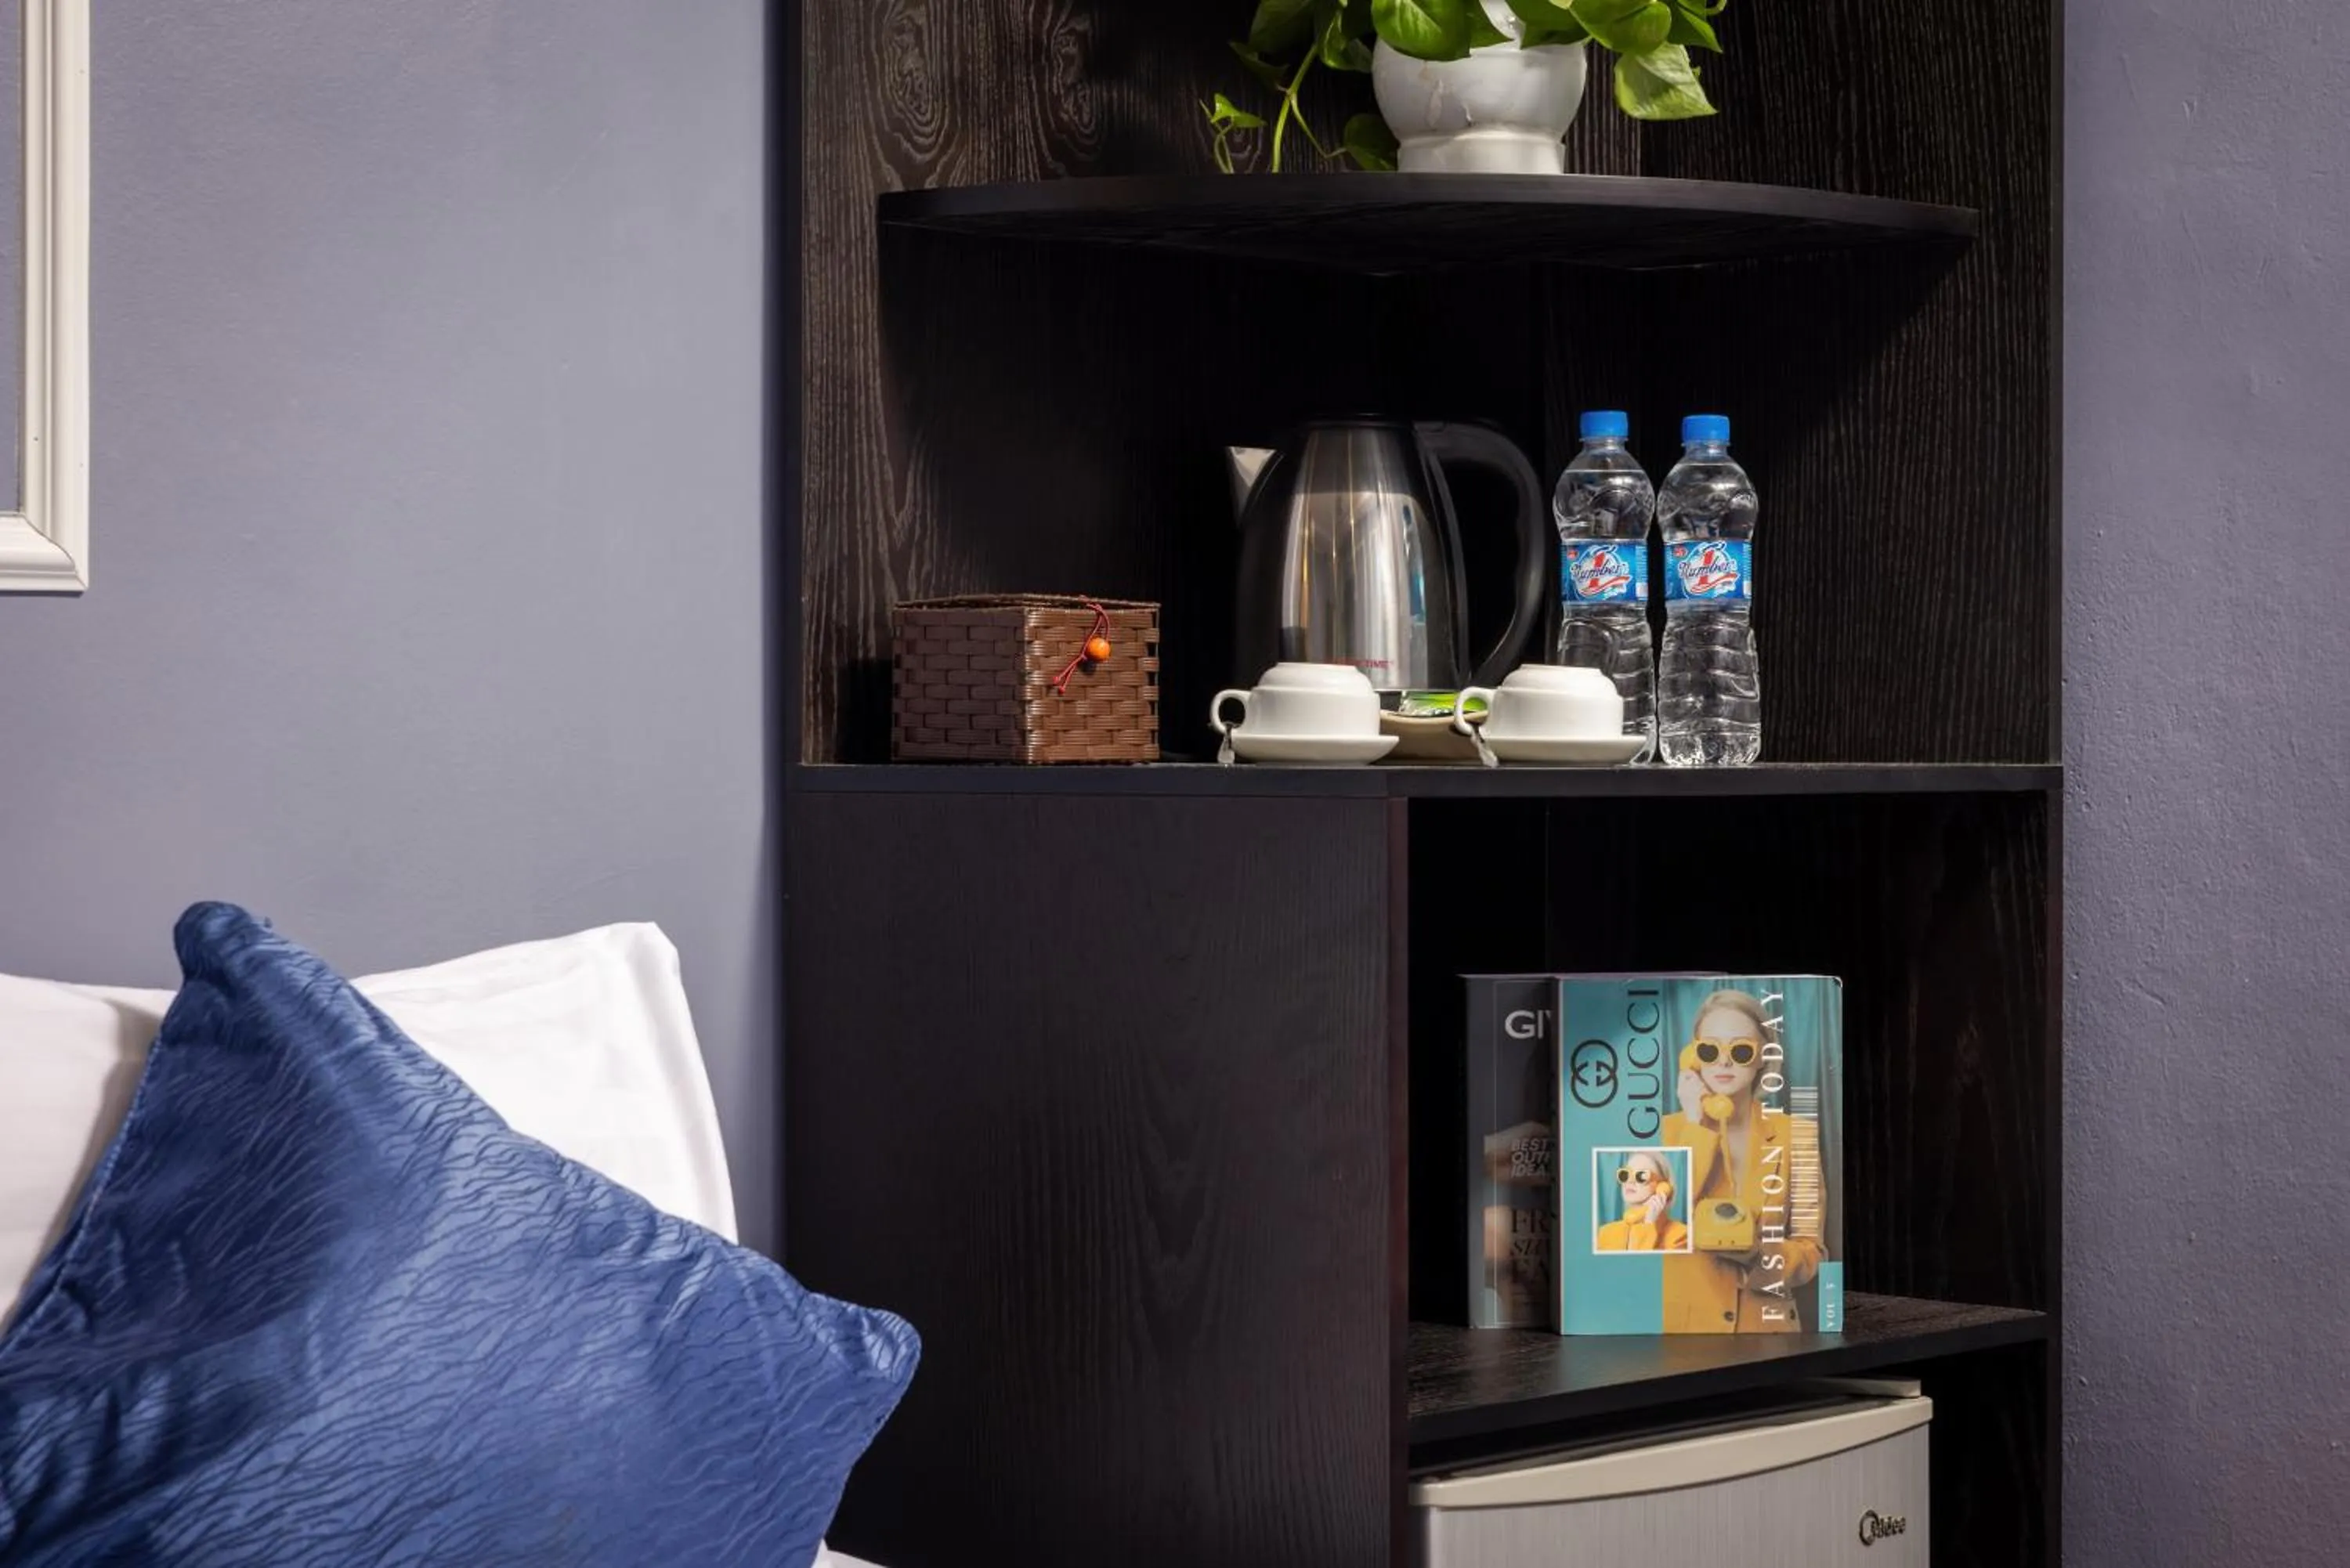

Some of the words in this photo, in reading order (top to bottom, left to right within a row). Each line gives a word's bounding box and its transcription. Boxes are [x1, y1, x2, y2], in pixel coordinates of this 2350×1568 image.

[1626, 989, 1661, 1140] GUCCI
[1760, 988, 1784, 1120] TODAY
[1760, 1146, 1785, 1321] FASHION
